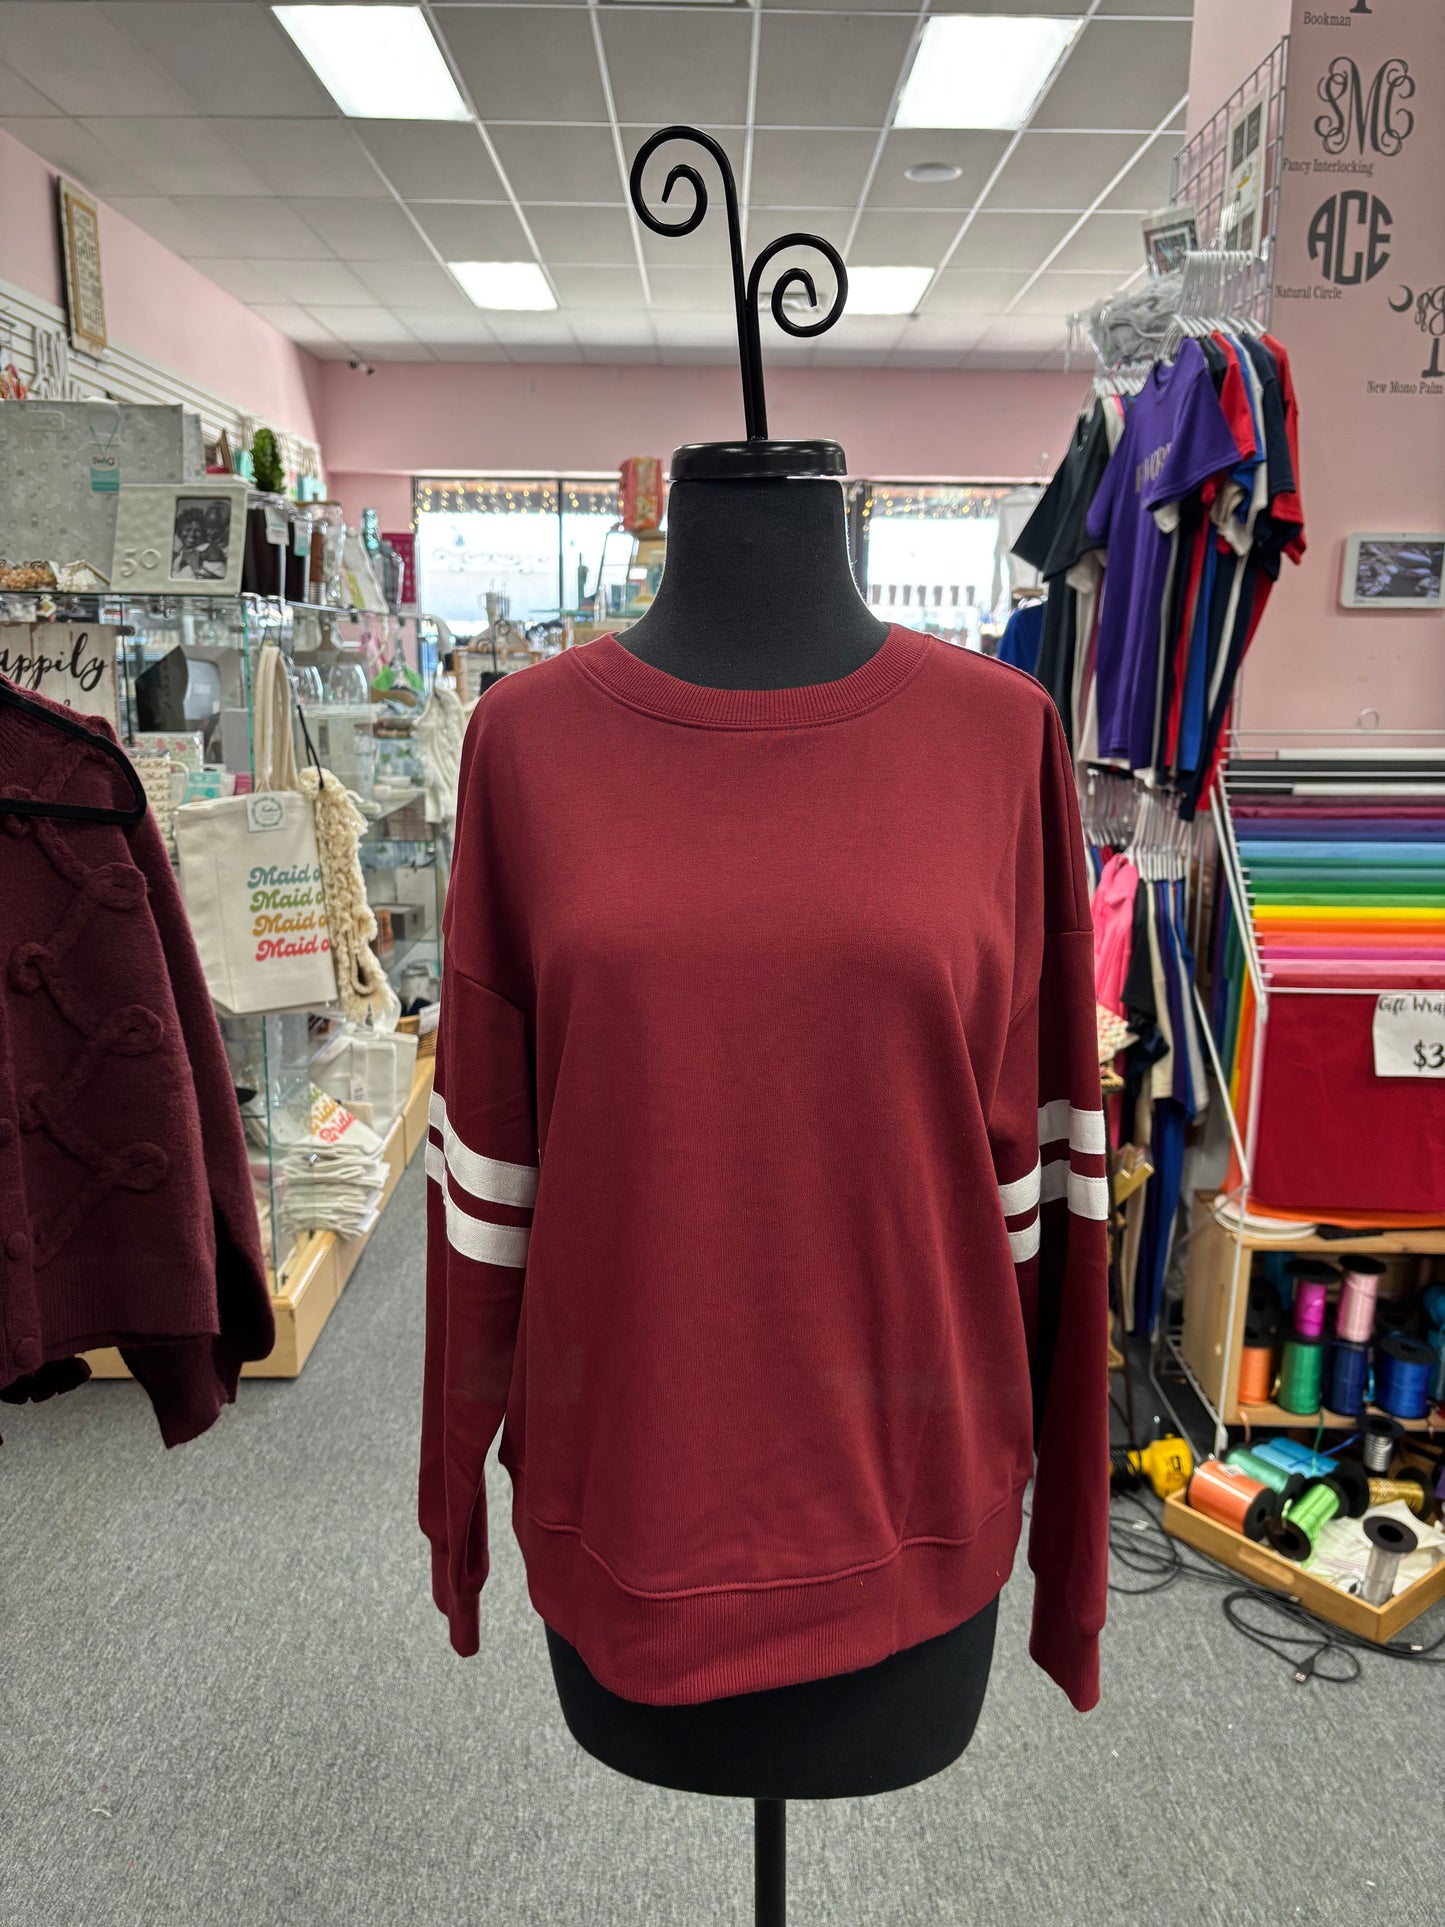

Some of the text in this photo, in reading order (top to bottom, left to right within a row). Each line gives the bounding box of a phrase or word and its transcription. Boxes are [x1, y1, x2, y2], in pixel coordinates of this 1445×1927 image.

[1303, 11, 1351, 26] Bookman
[1282, 157, 1311, 175] Fancy
[1307, 189, 1393, 285] ACE
[120, 547, 161, 577] 50
[247, 863, 311, 889] Maid
[249, 887, 313, 913] Maid
[252, 911, 317, 937] Maid
[255, 934, 319, 962] Maid
[1379, 996, 1445, 1015] Gift Wra
[1413, 1038, 1445, 1071] $3
